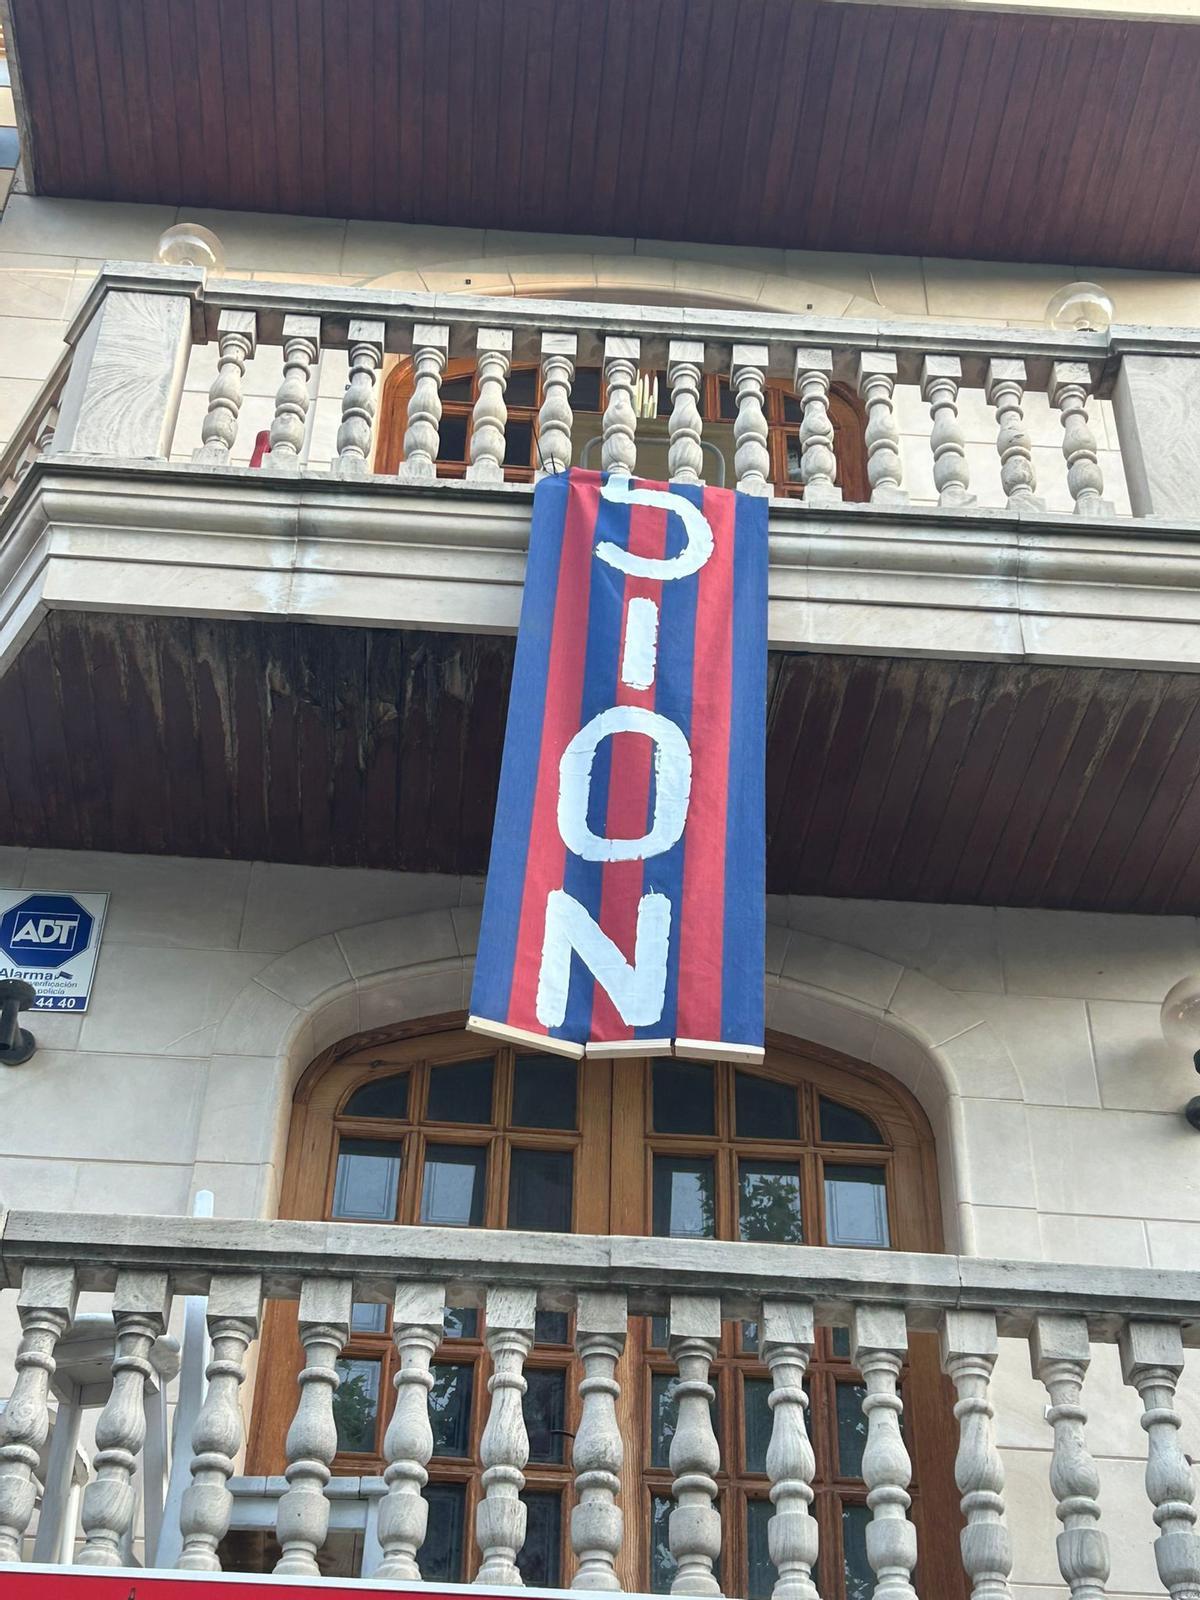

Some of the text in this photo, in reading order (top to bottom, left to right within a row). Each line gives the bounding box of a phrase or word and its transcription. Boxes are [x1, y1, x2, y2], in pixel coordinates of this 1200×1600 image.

[12, 919, 78, 944] ADT
[0, 968, 54, 980] Alarma
[35, 997, 76, 1009] 44 40
